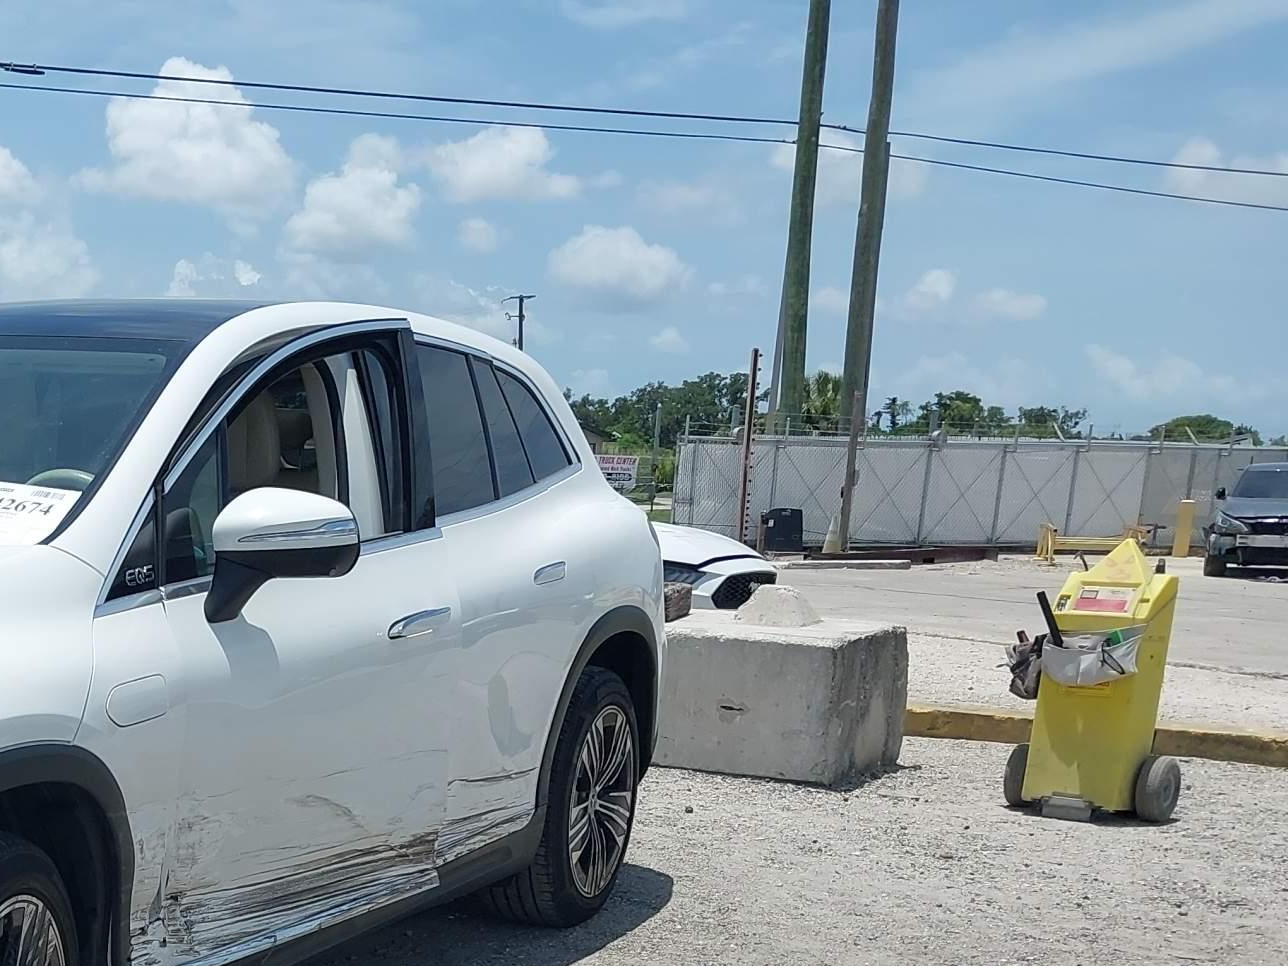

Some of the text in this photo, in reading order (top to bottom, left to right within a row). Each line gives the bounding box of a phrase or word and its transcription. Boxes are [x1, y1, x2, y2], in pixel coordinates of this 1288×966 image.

[600, 456, 637, 465] TRUCK CENTER
[125, 564, 155, 587] EQS
